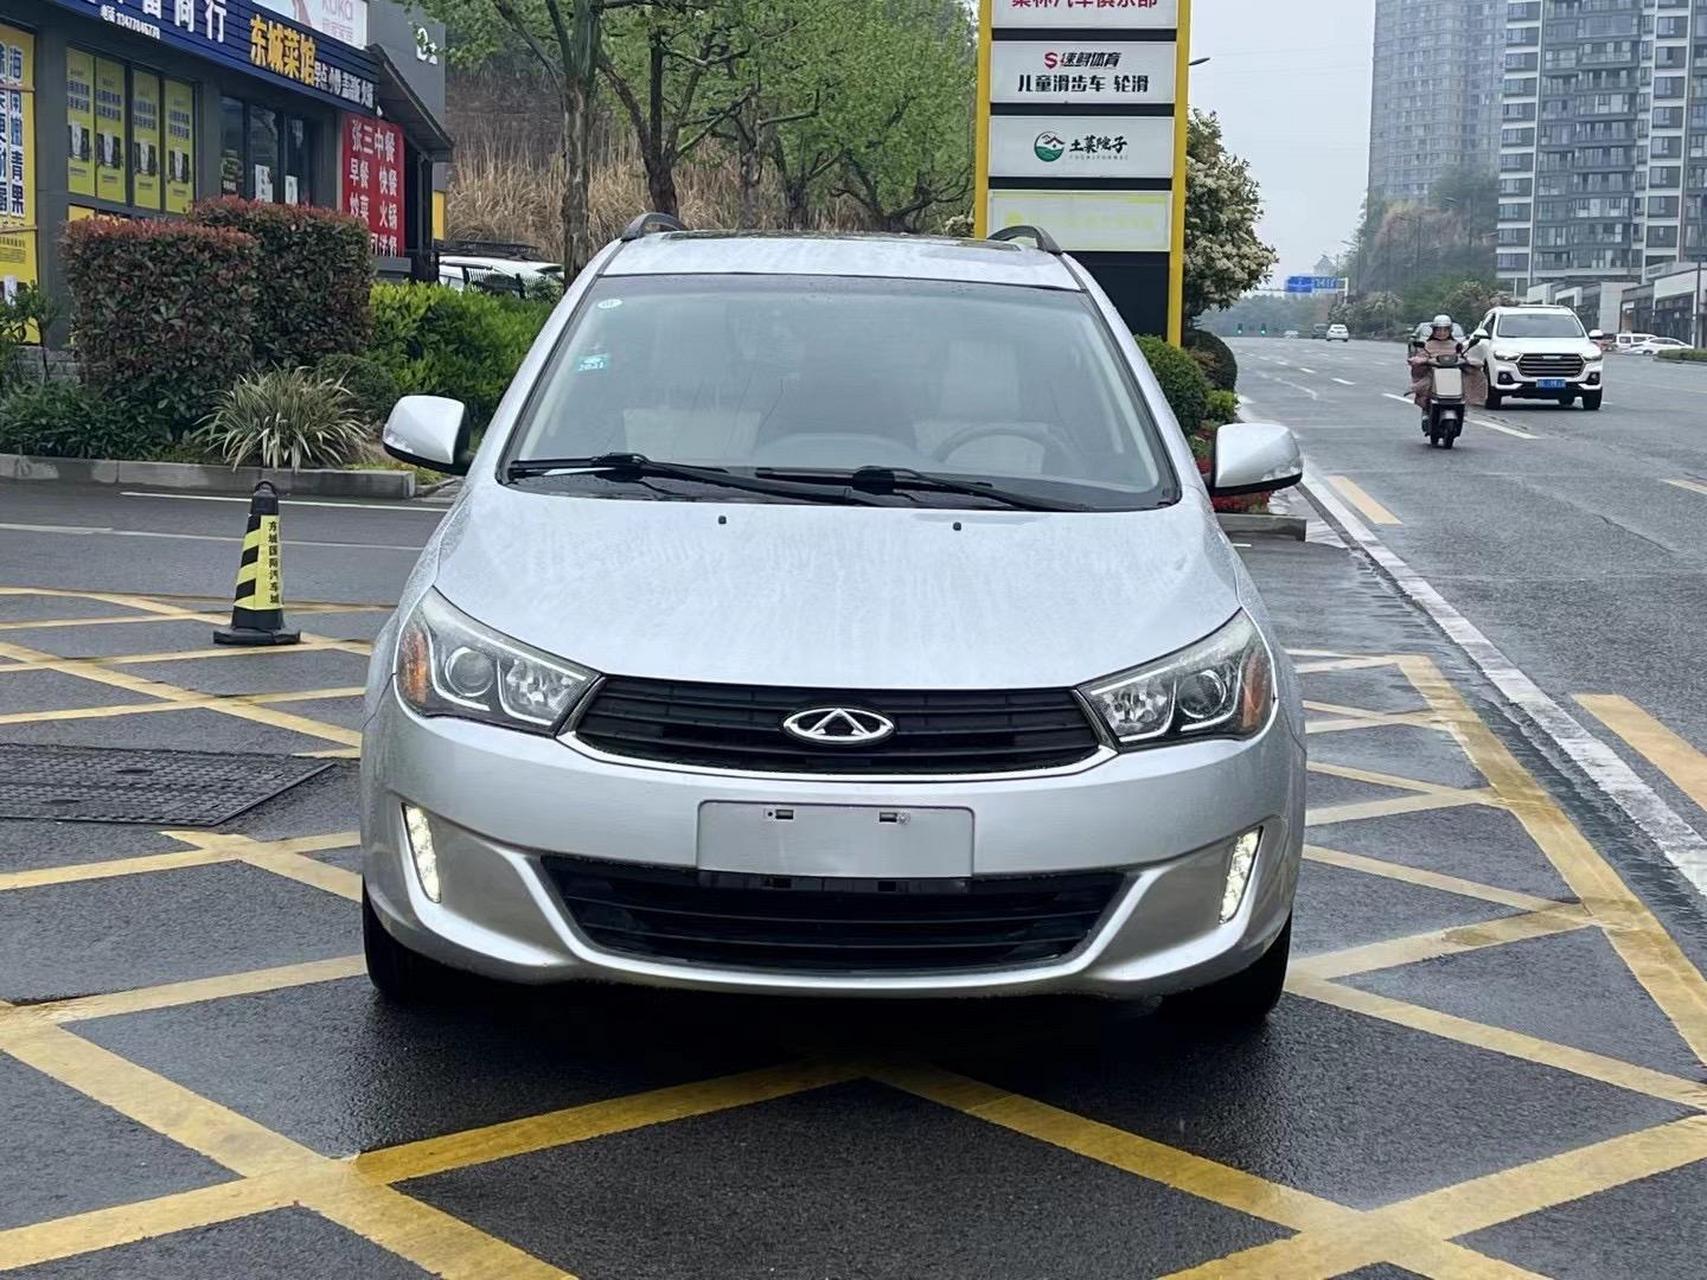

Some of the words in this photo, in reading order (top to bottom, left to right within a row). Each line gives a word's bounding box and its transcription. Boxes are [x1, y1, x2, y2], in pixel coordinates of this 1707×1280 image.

[250, 13, 315, 87] 东城菜馆
[1018, 75, 1105, 92] 儿童滑步车
[1114, 75, 1149, 92] 轮滑
[352, 119, 395, 163] 张三中餐
[1069, 135, 1128, 154] 土菜院子
[350, 157, 369, 189] 早餐
[379, 165, 397, 196] 快餐
[379, 200, 397, 230] 火锅
